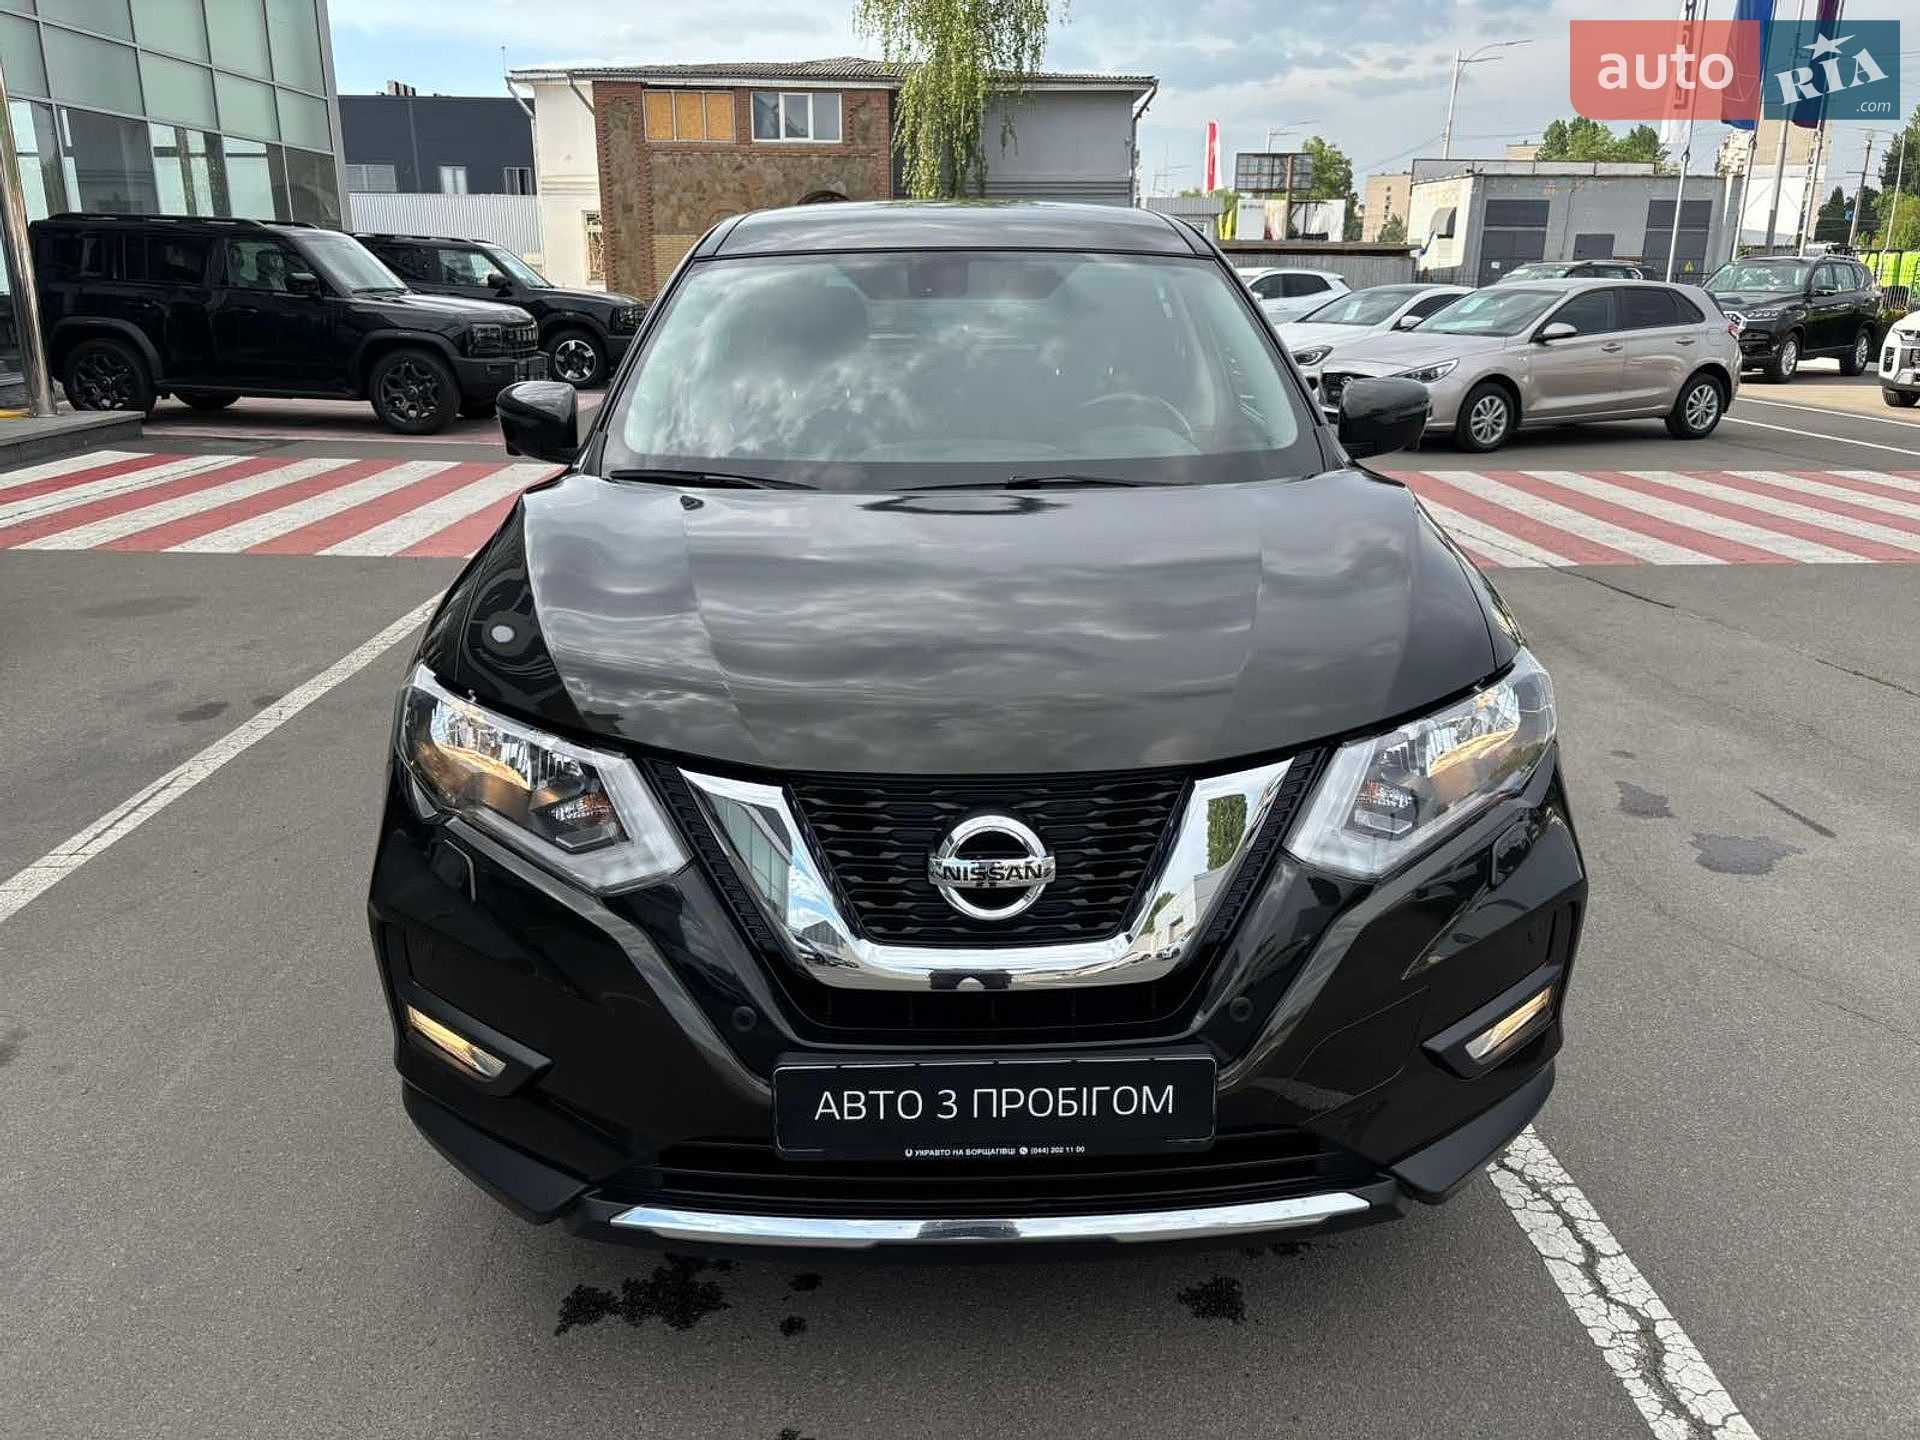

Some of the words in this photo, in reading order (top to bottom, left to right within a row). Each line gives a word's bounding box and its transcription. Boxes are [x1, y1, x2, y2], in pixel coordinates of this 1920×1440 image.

[942, 863, 1042, 882] NISSAN
[814, 1090, 923, 1121] АВТО
[973, 1084, 1174, 1119] ПРОБІГОМ
[952, 1149, 964, 1157] НА
